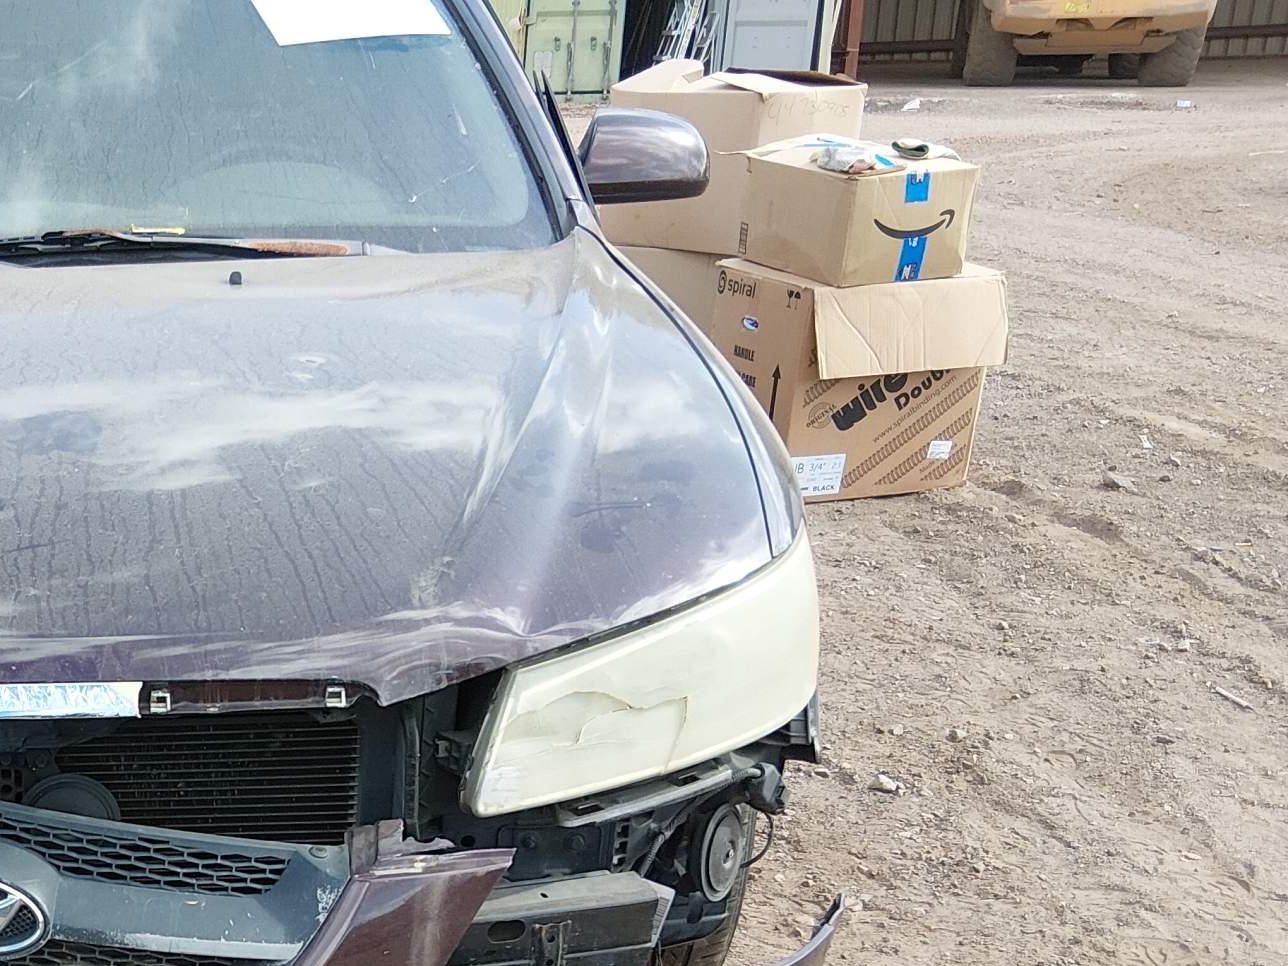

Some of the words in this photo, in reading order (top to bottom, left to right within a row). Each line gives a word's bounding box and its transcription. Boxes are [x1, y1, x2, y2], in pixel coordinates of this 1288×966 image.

[727, 279, 757, 299] spiral
[734, 344, 755, 362] HANDLE
[812, 484, 835, 492] BLACK
